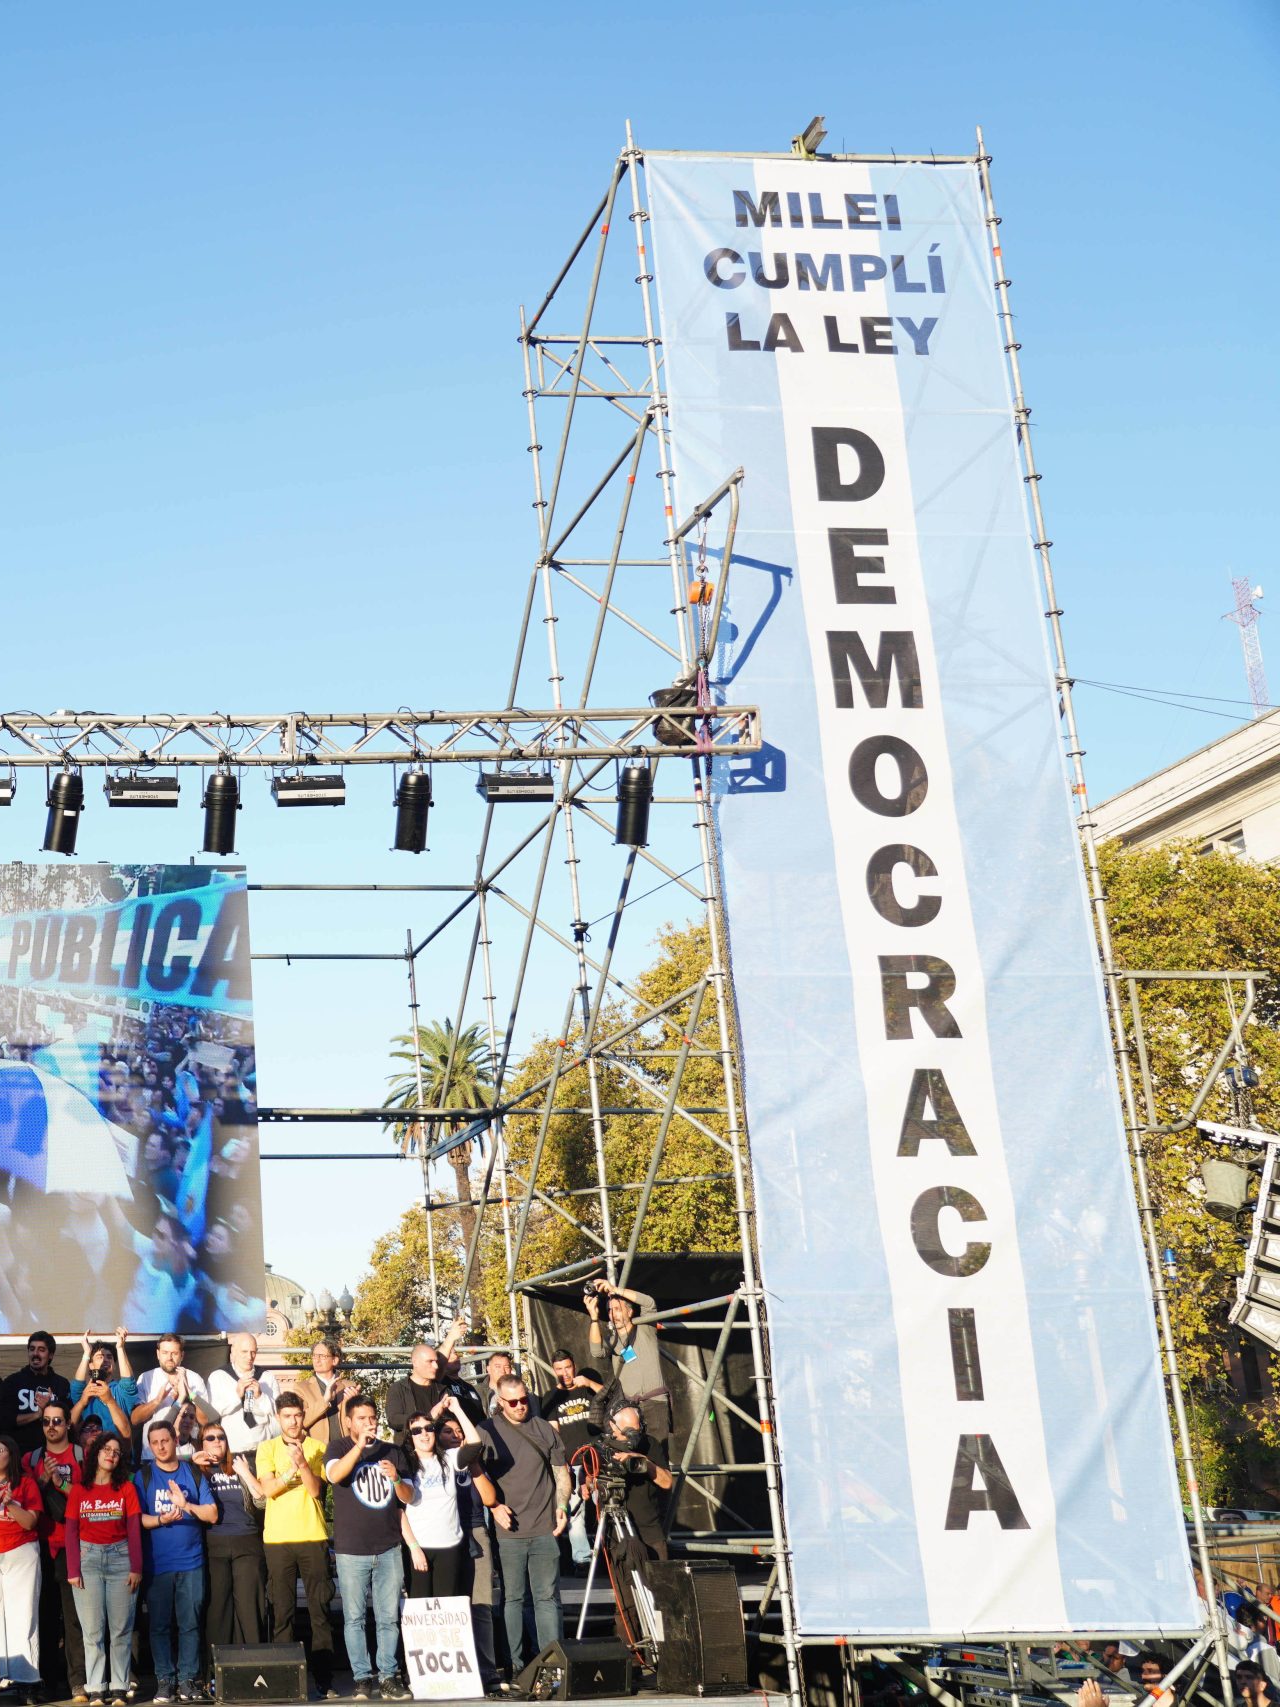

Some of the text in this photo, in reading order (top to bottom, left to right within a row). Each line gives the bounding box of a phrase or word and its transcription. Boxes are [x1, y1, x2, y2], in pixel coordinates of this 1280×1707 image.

[732, 190, 902, 231] MILEI
[703, 243, 946, 294] CUMPLÍ
[725, 311, 939, 356] LA LEY
[7, 888, 253, 1001] PUBLICA
[811, 426, 1031, 1530] DEMOCRACIA
[401, 1611, 468, 1627] UNIVERSIDAD
[426, 1597, 441, 1611] LA
[408, 1649, 473, 1677] TOCA
